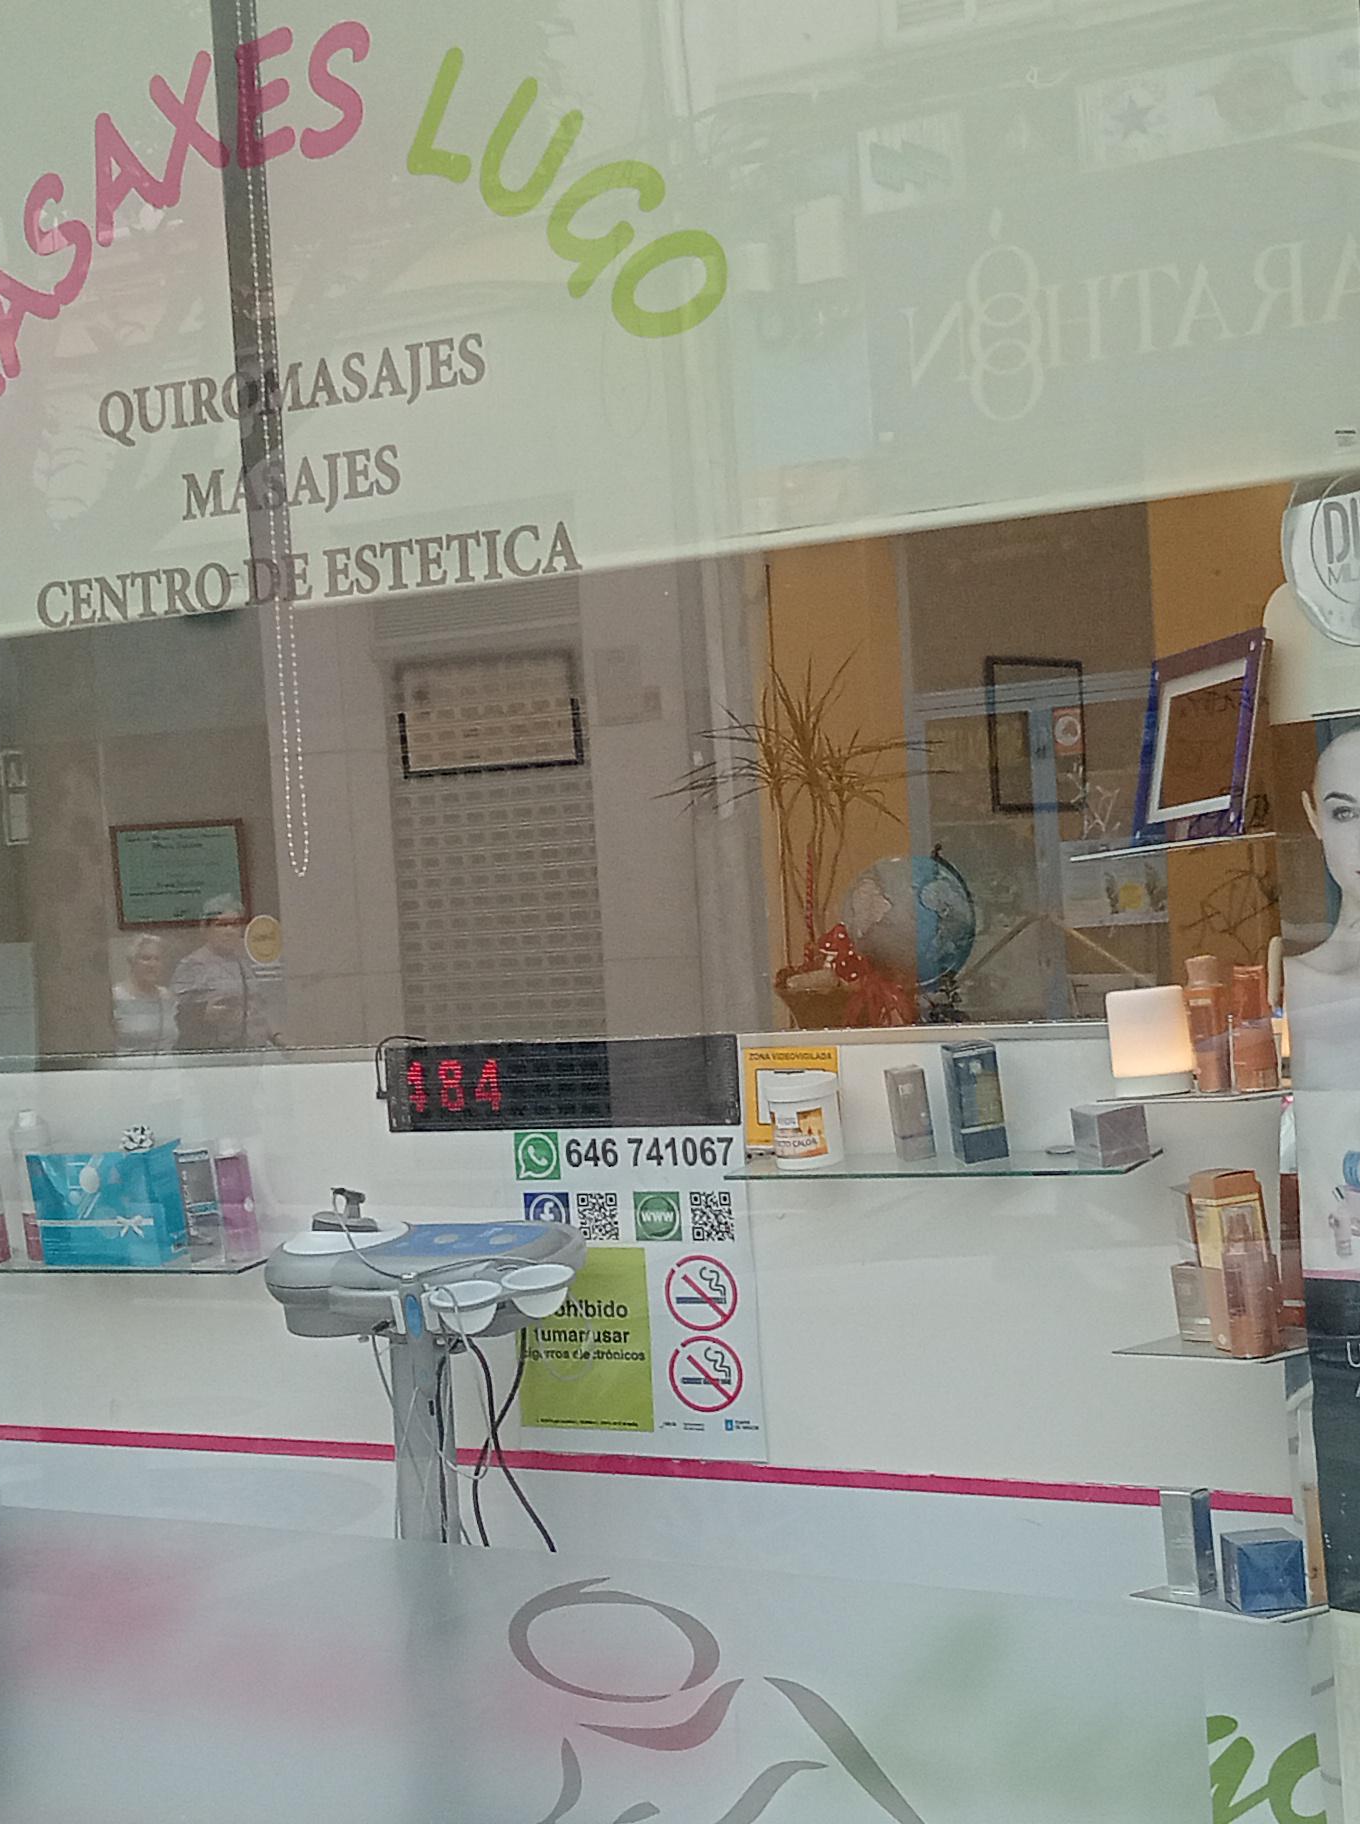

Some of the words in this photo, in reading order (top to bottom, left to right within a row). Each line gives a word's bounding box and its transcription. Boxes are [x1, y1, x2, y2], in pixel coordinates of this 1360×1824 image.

[406, 46, 729, 339] LUGO
[98, 333, 487, 447] QUIROMASAJES
[181, 444, 401, 522] MASAJES
[38, 561, 233, 630] CENTRO
[243, 552, 312, 606] DE
[323, 520, 583, 599] ESTETICA
[565, 1137, 619, 1168] 646
[627, 1136, 734, 1167] 741067
[555, 1299, 628, 1319] ohibido
